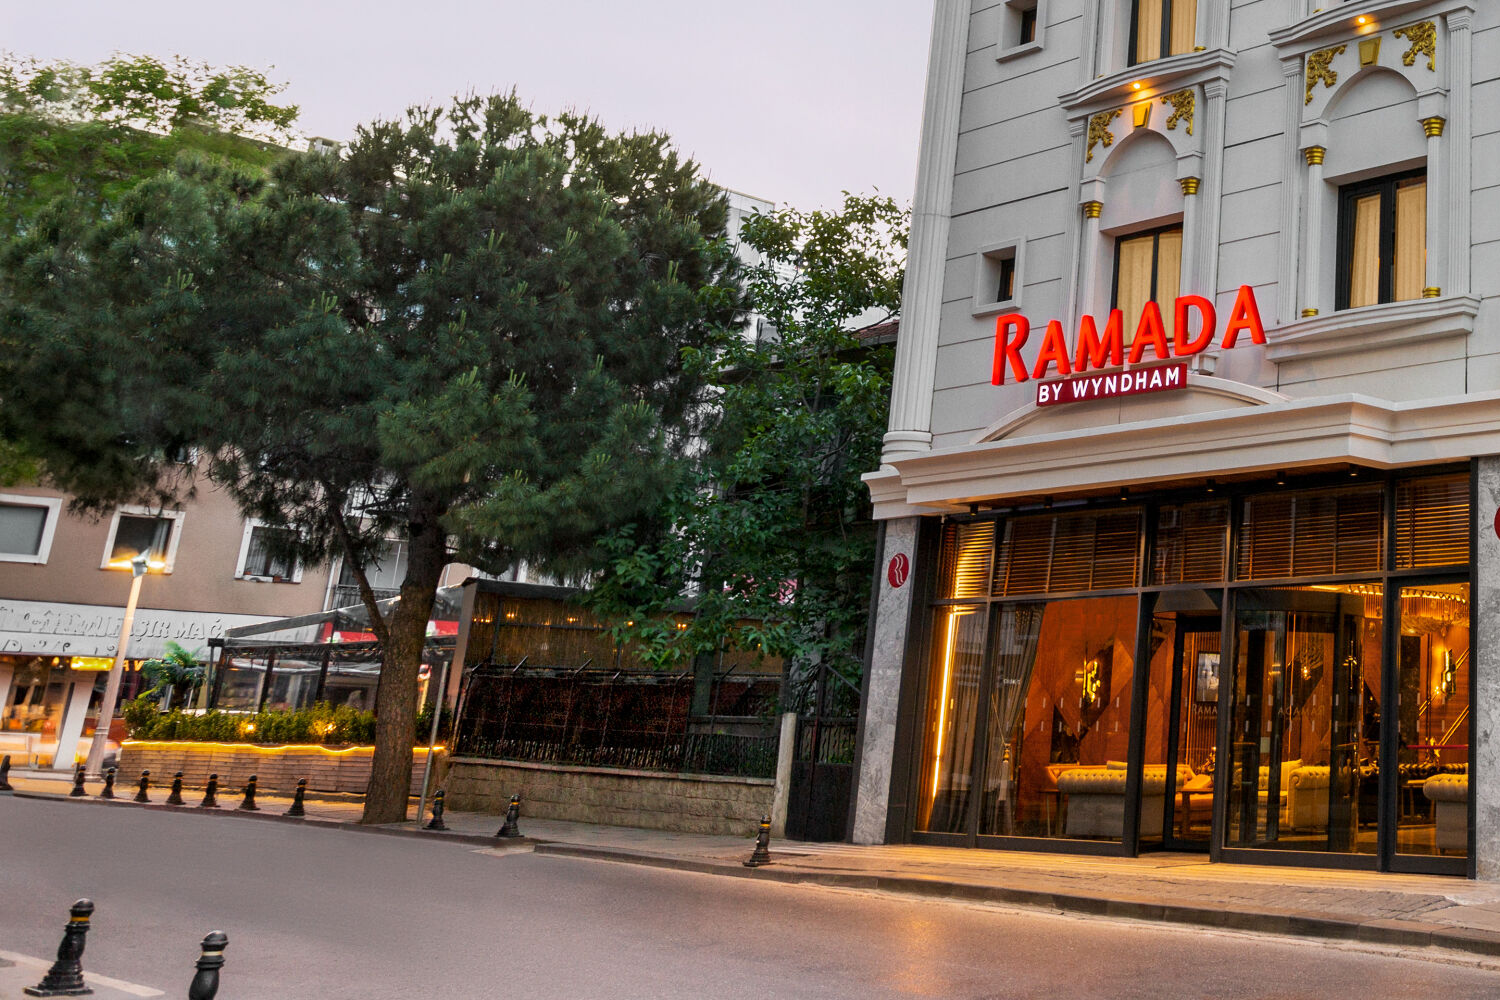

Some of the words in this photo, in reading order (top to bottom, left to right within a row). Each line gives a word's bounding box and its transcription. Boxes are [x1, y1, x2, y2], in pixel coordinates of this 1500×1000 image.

[991, 285, 1267, 385] RAMADA
[1038, 382, 1063, 403] BY
[1072, 367, 1180, 398] WYNDHAM
[1192, 703, 1218, 715] RAMA
